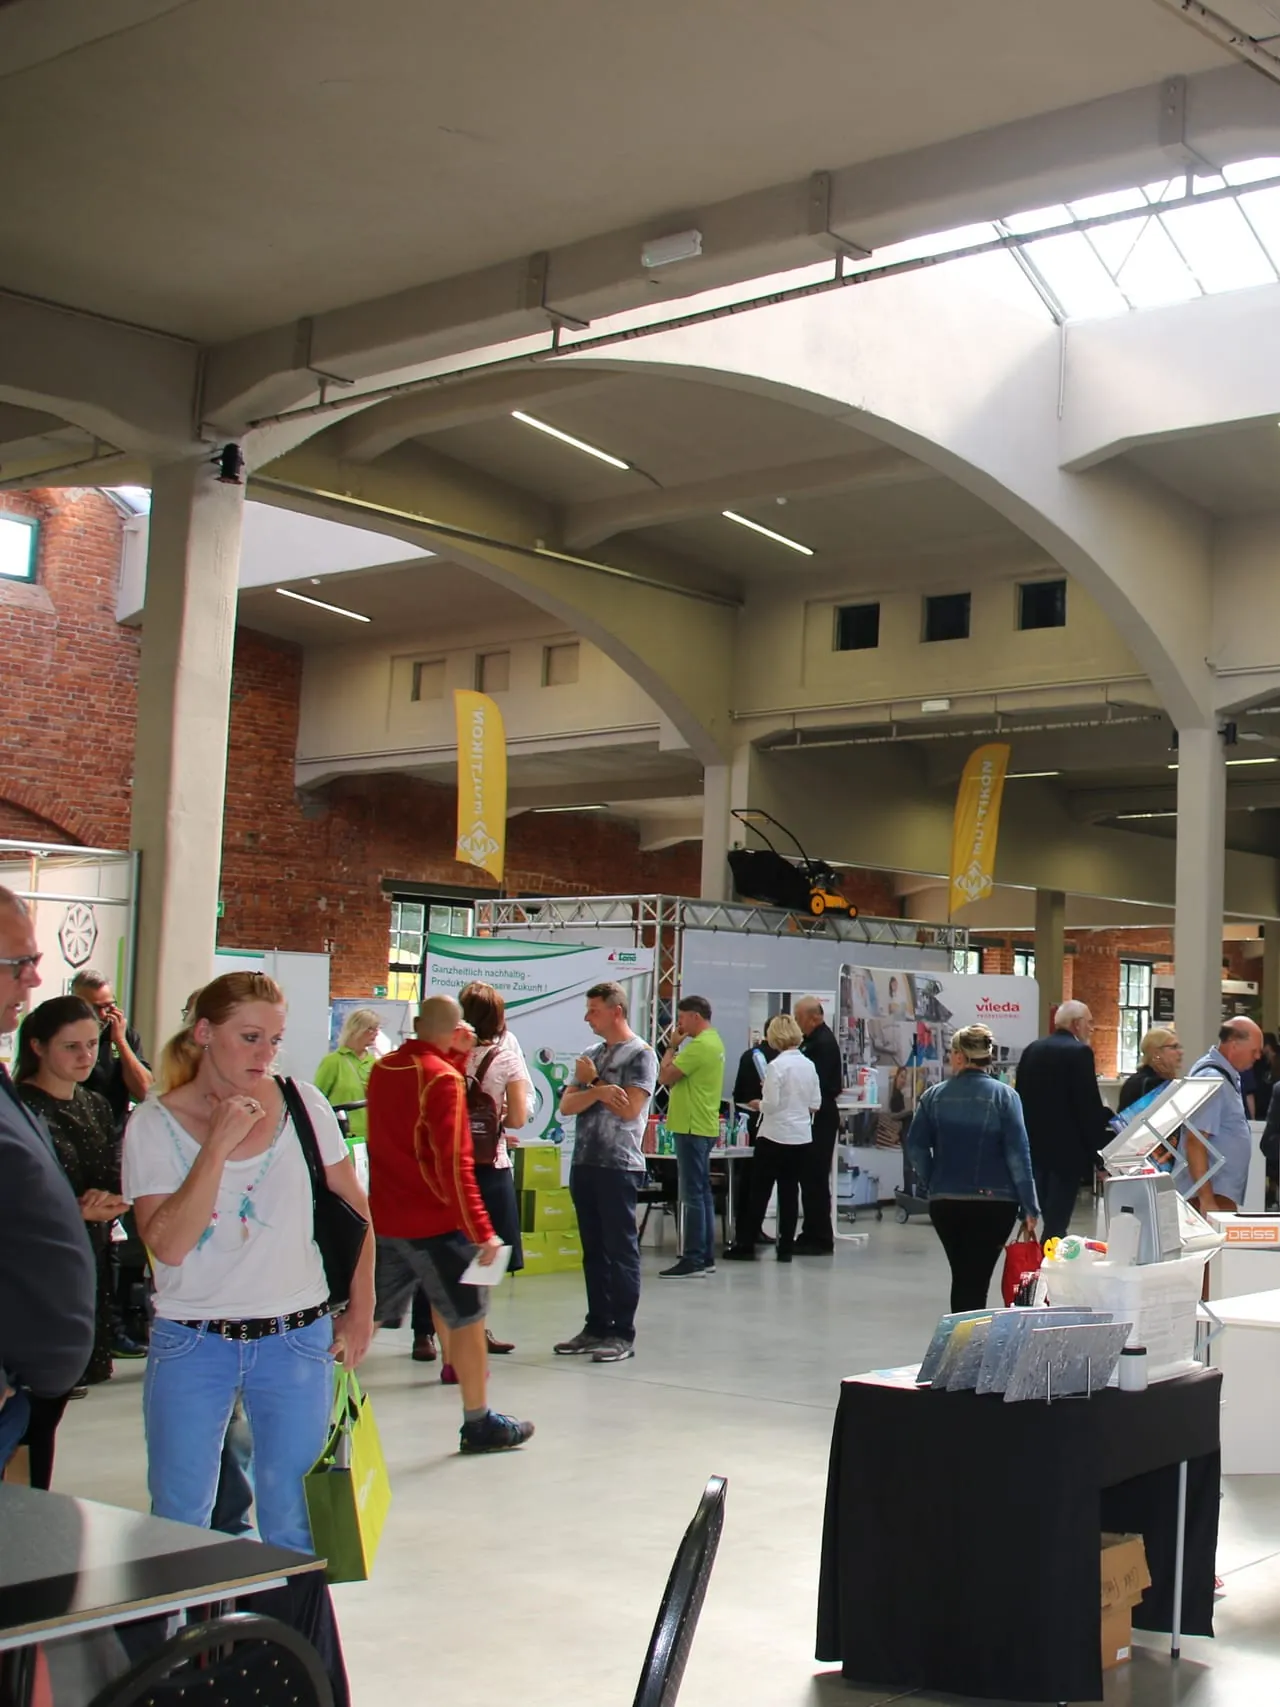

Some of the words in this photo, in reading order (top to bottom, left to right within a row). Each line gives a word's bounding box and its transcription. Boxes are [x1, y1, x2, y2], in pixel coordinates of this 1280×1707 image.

[432, 963, 483, 976] Ganzheitlich
[485, 969, 525, 981] nachhaltig
[432, 977, 465, 987] Produkt
[513, 982, 542, 992] Zukunft
[975, 997, 1020, 1012] vileda
